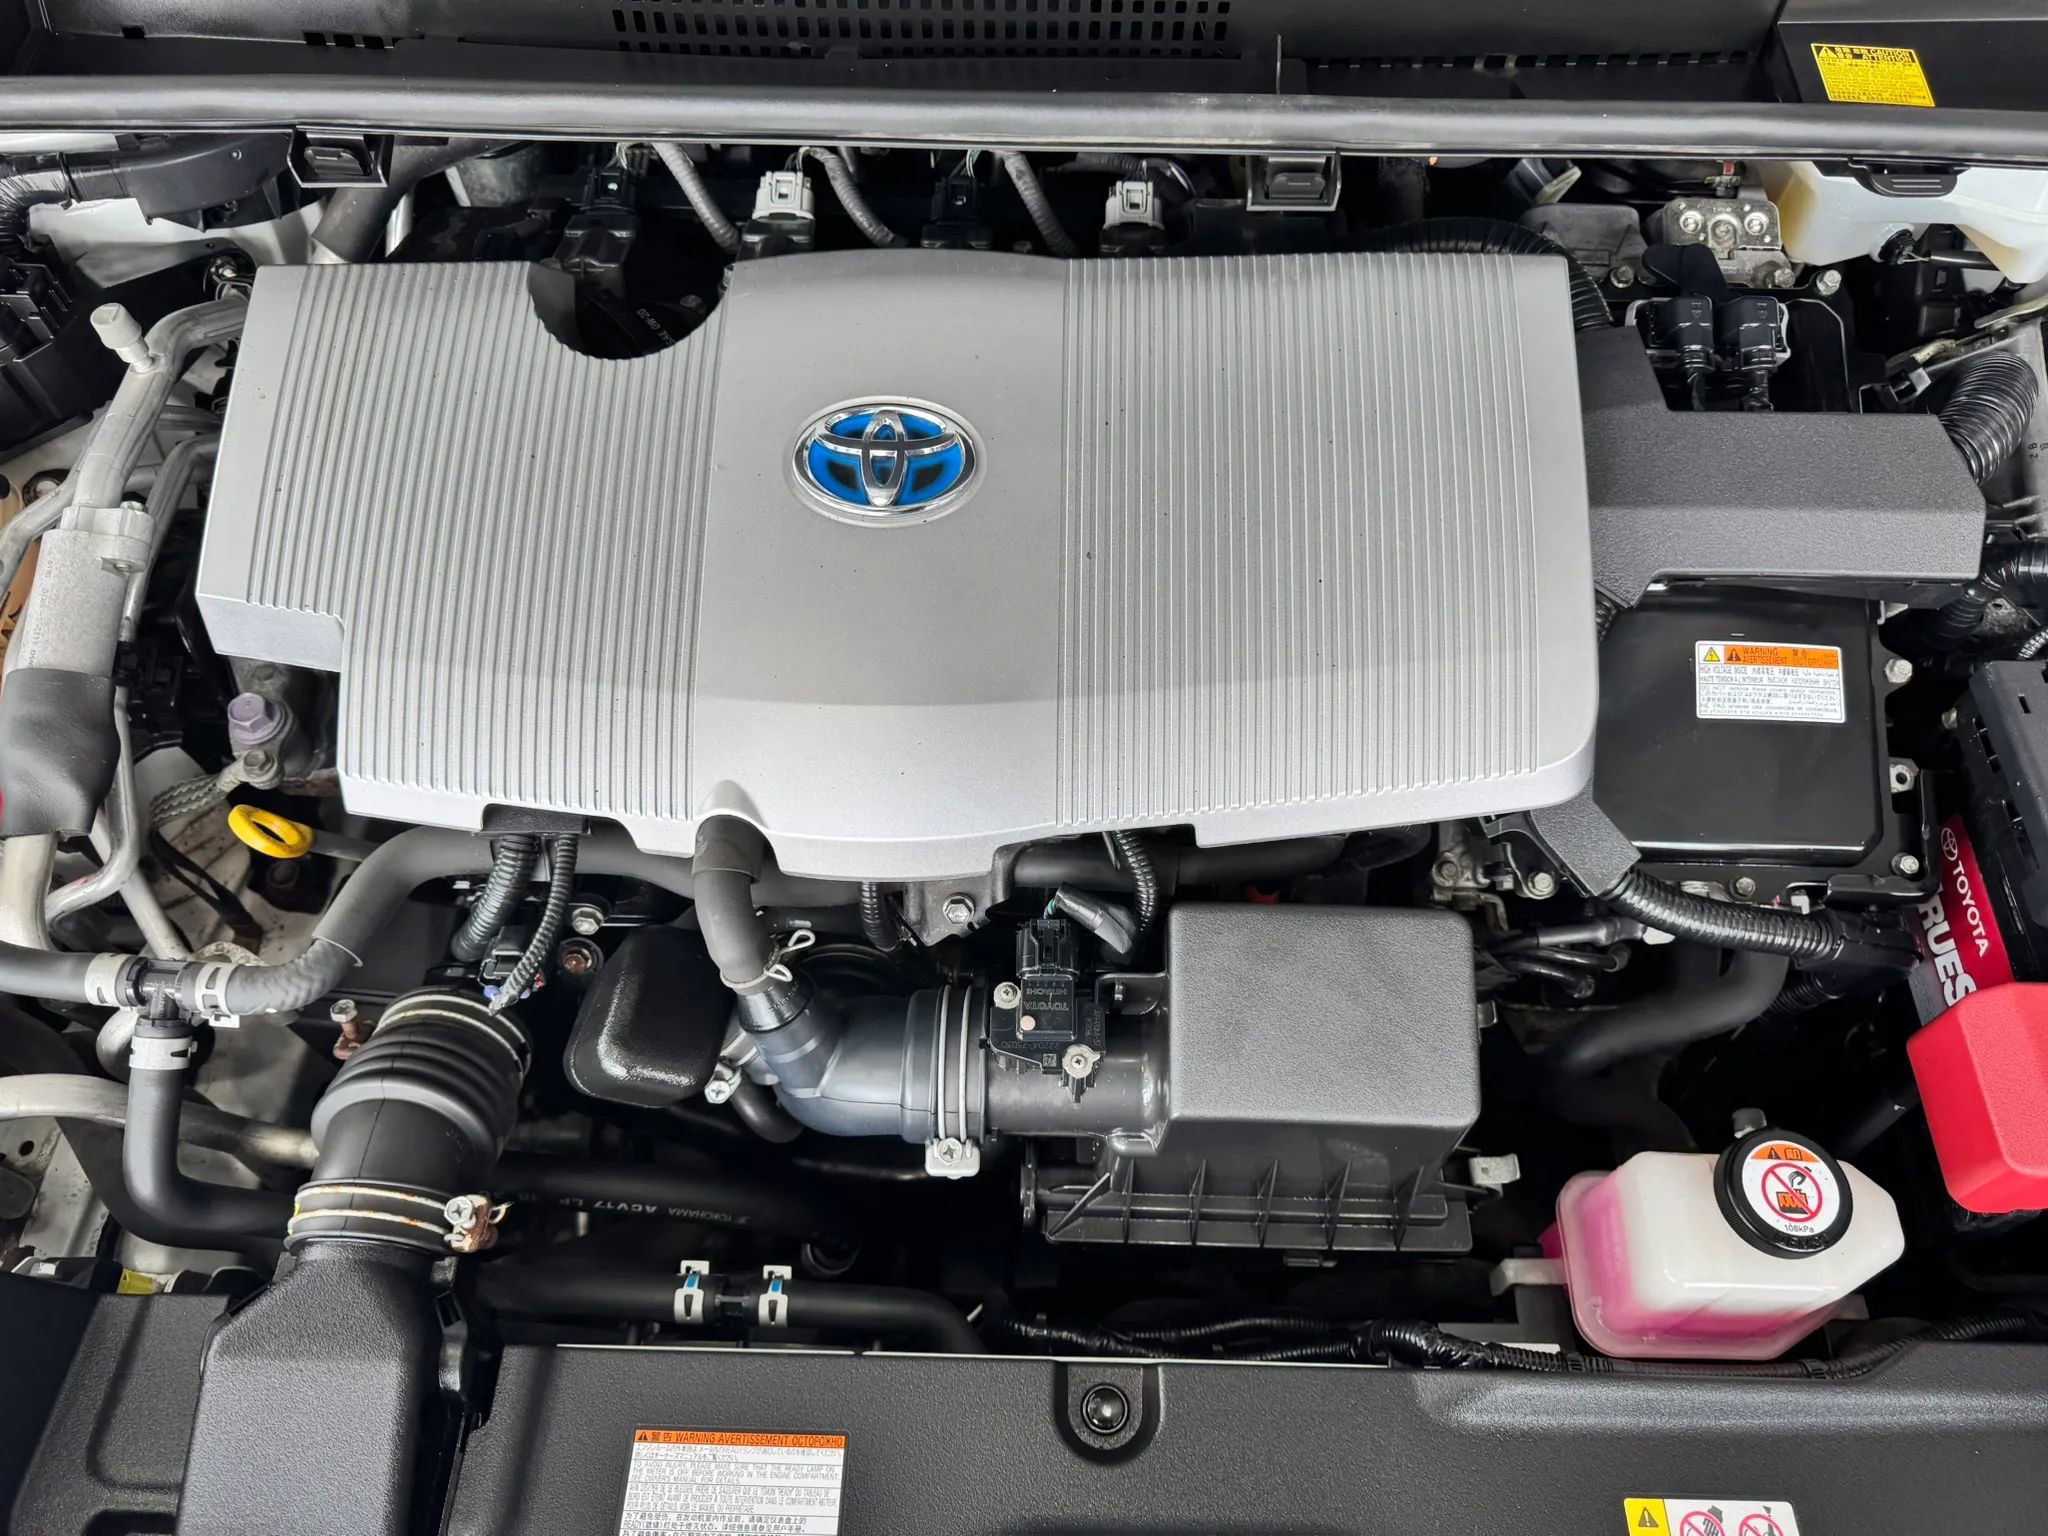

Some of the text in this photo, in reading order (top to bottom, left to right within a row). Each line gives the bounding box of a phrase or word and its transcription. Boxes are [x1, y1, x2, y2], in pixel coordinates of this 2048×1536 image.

[1862, 54, 1912, 62] ATTENTION
[1870, 49, 1909, 57] CAUTION
[1743, 647, 1778, 656] WARNING
[1743, 656, 1787, 665] AVERTISSEMENT
[1952, 860, 1989, 958] TOYOTA
[1916, 882, 1977, 1007] RUES
[1023, 1001, 1069, 1011] TOYOTA
[593, 1199, 657, 1214] ACV17
[668, 1206, 732, 1222] YOKOHAMA
[676, 1433, 789, 1445] WARNING AVERTISSEMENT
